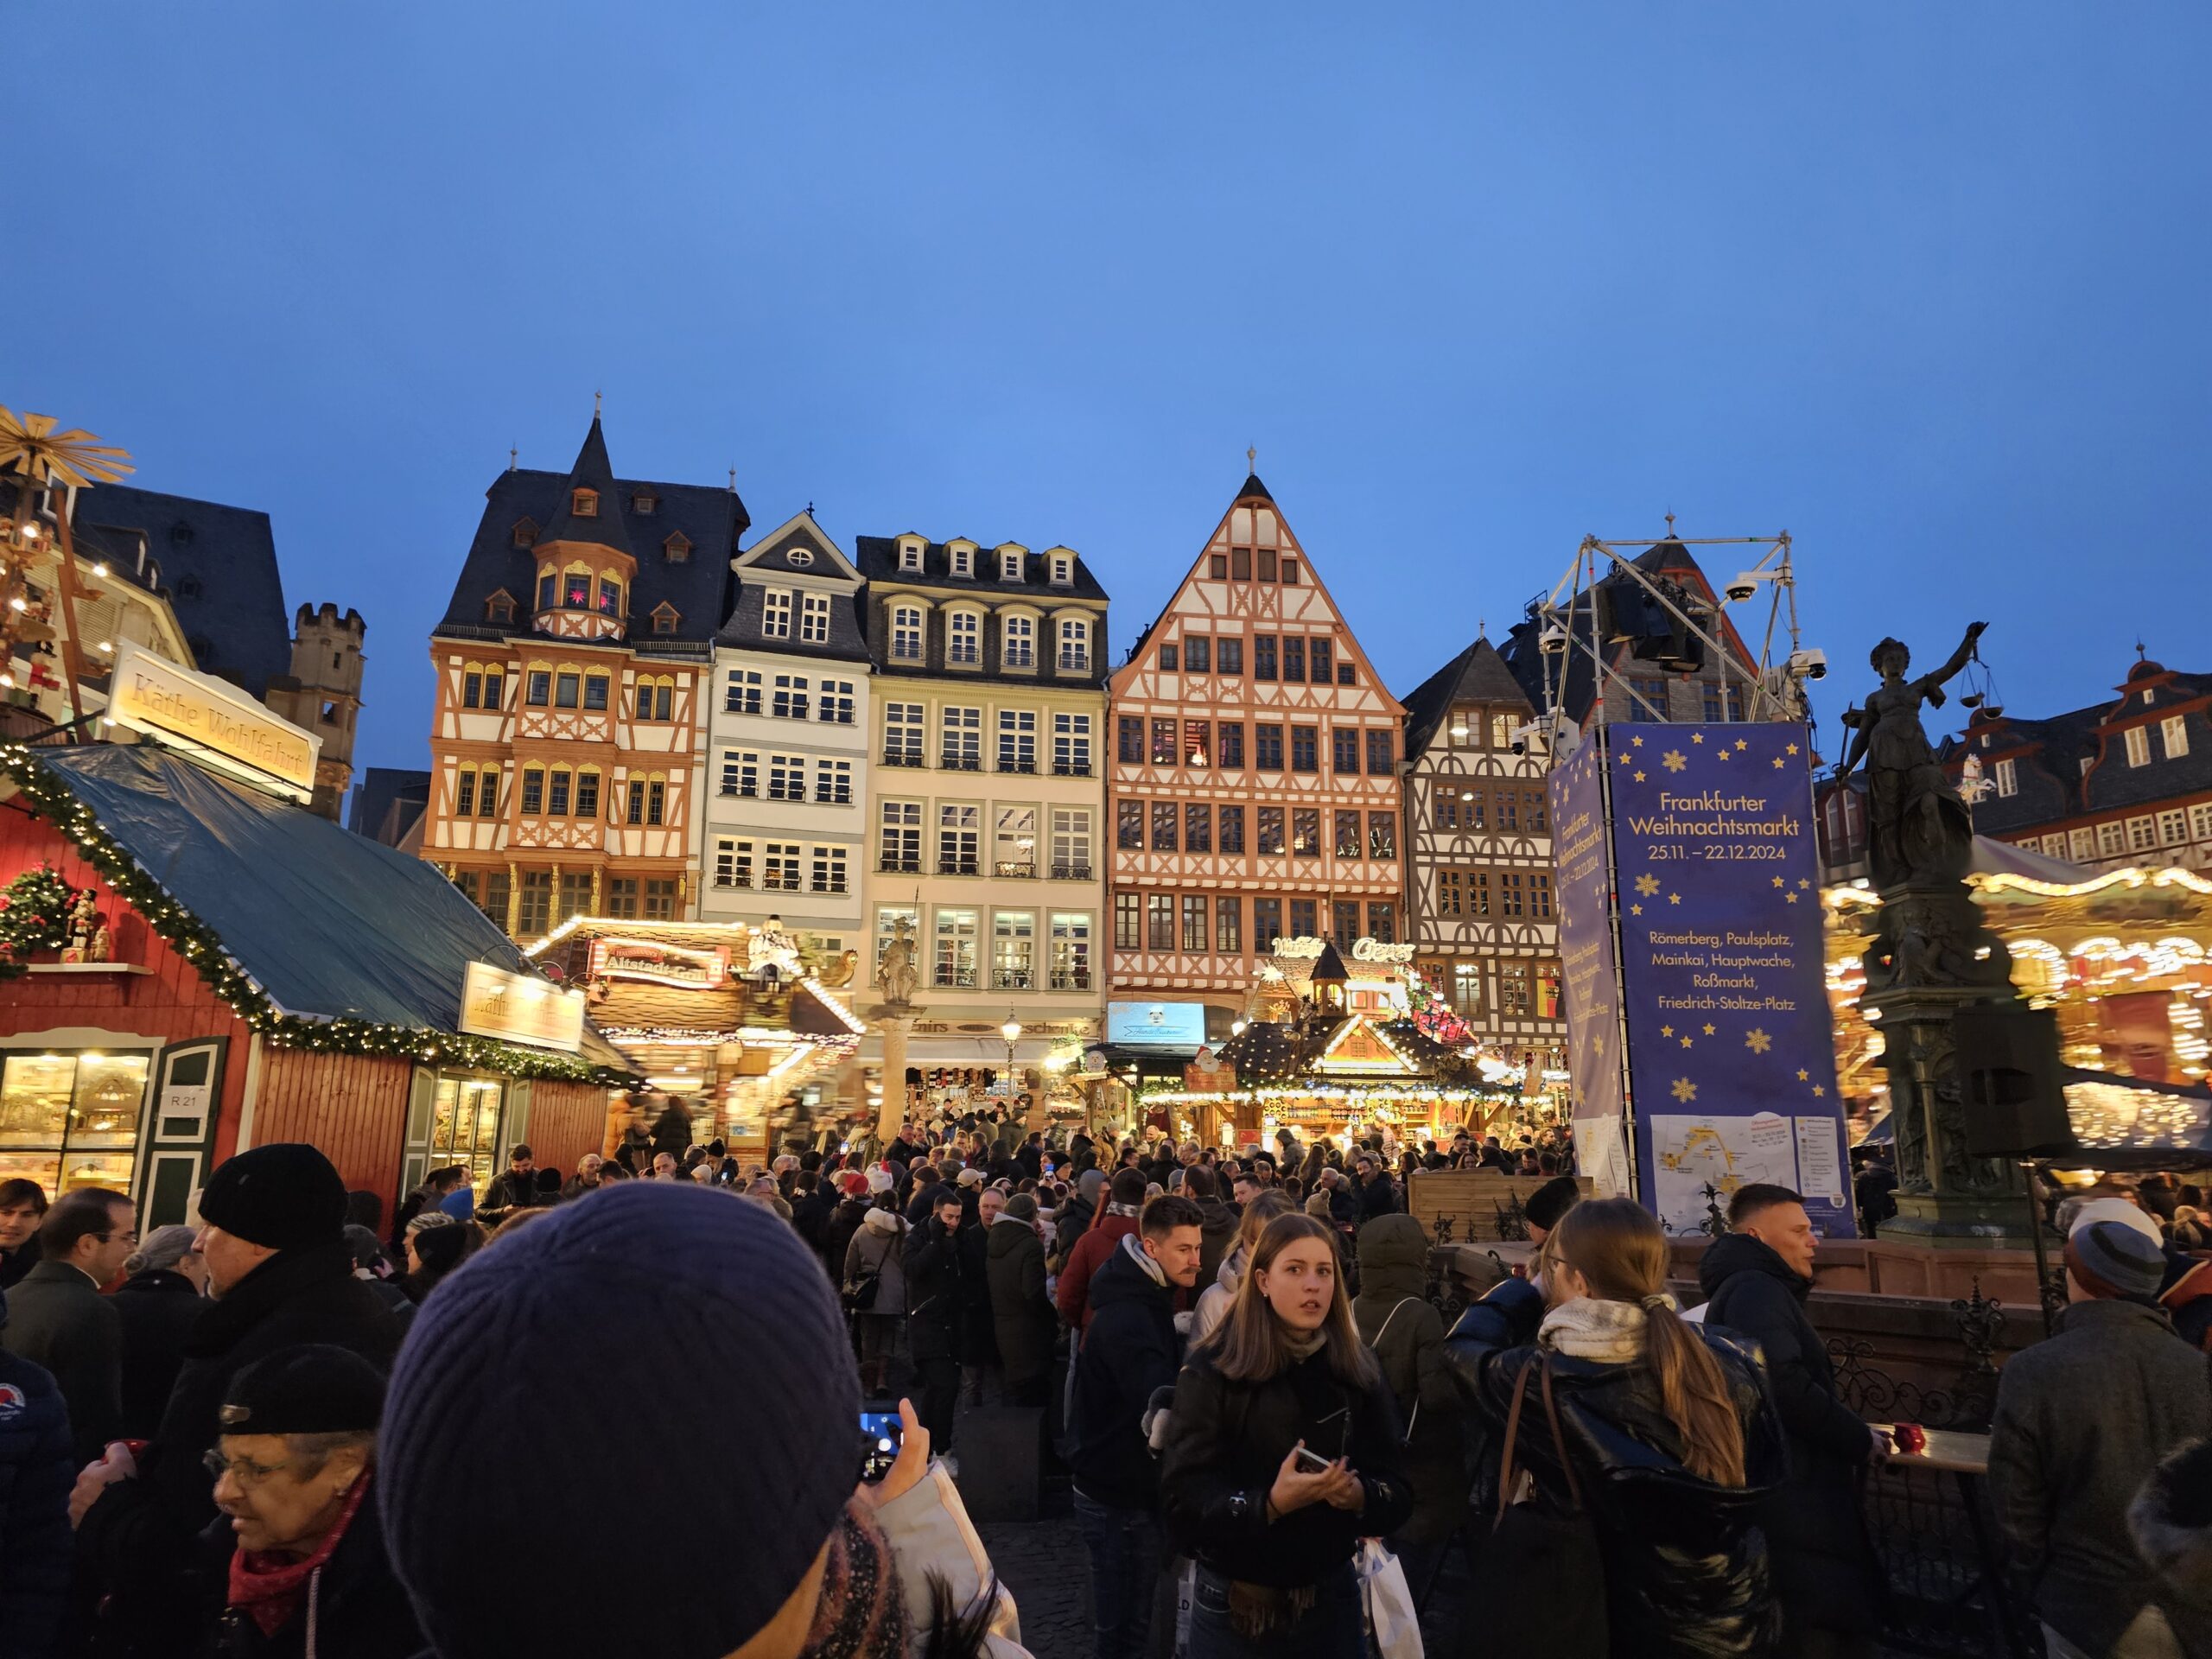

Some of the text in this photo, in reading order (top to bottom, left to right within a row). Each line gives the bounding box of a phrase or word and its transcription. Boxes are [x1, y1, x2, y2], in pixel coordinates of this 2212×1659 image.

[131, 672, 303, 775] Käthe Wohlfahrt
[1660, 790, 1767, 811] Frankfurter
[1628, 814, 1799, 836] Weihnachtsmarkt
[1648, 845, 1689, 860] 25.11.
[1704, 845, 1787, 860] 22.12.2024
[1649, 931, 1795, 949] Römerberg, Paulsplatz,
[1651, 951, 1796, 969] Mainkai, Hauptwache,
[1694, 973, 1759, 990] Roßmarkt,
[1658, 995, 1796, 1010] Friedrich-Stoltze-Platz
[171, 1096, 196, 1107] R 21
